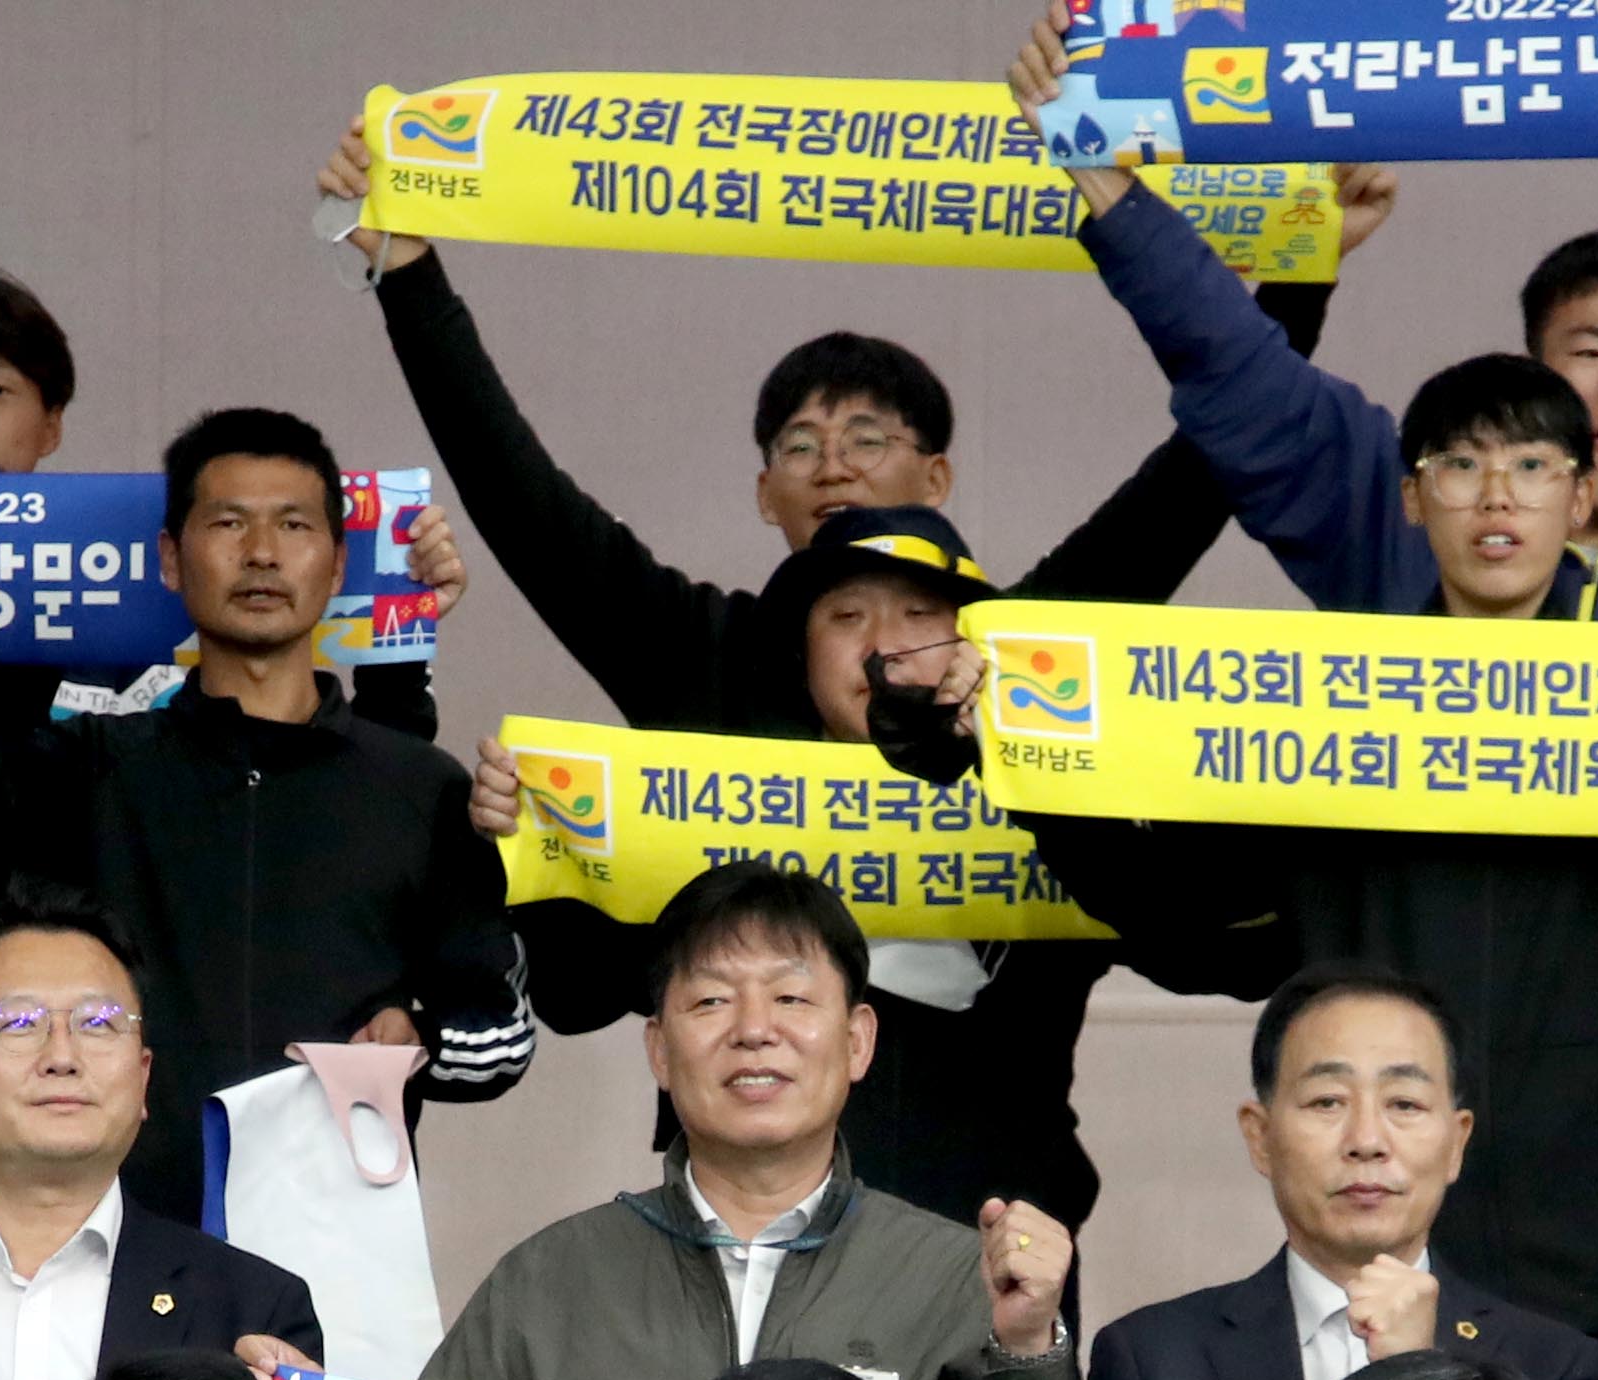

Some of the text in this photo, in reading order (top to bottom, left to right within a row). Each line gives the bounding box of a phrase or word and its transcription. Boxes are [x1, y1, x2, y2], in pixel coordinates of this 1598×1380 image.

[1281, 36, 1562, 128] 전라남도
[515, 94, 1044, 166] 제43회 전국장애인체육
[390, 169, 482, 198] 전라남도
[571, 161, 1080, 239] 제104회 전국체육대회
[1169, 166, 1286, 198] 전남으로
[1127, 645, 1303, 706] 제43회
[997, 742, 1097, 772] 전라남도
[1194, 727, 1399, 788] 제104회
[639, 765, 806, 828] 제43회
